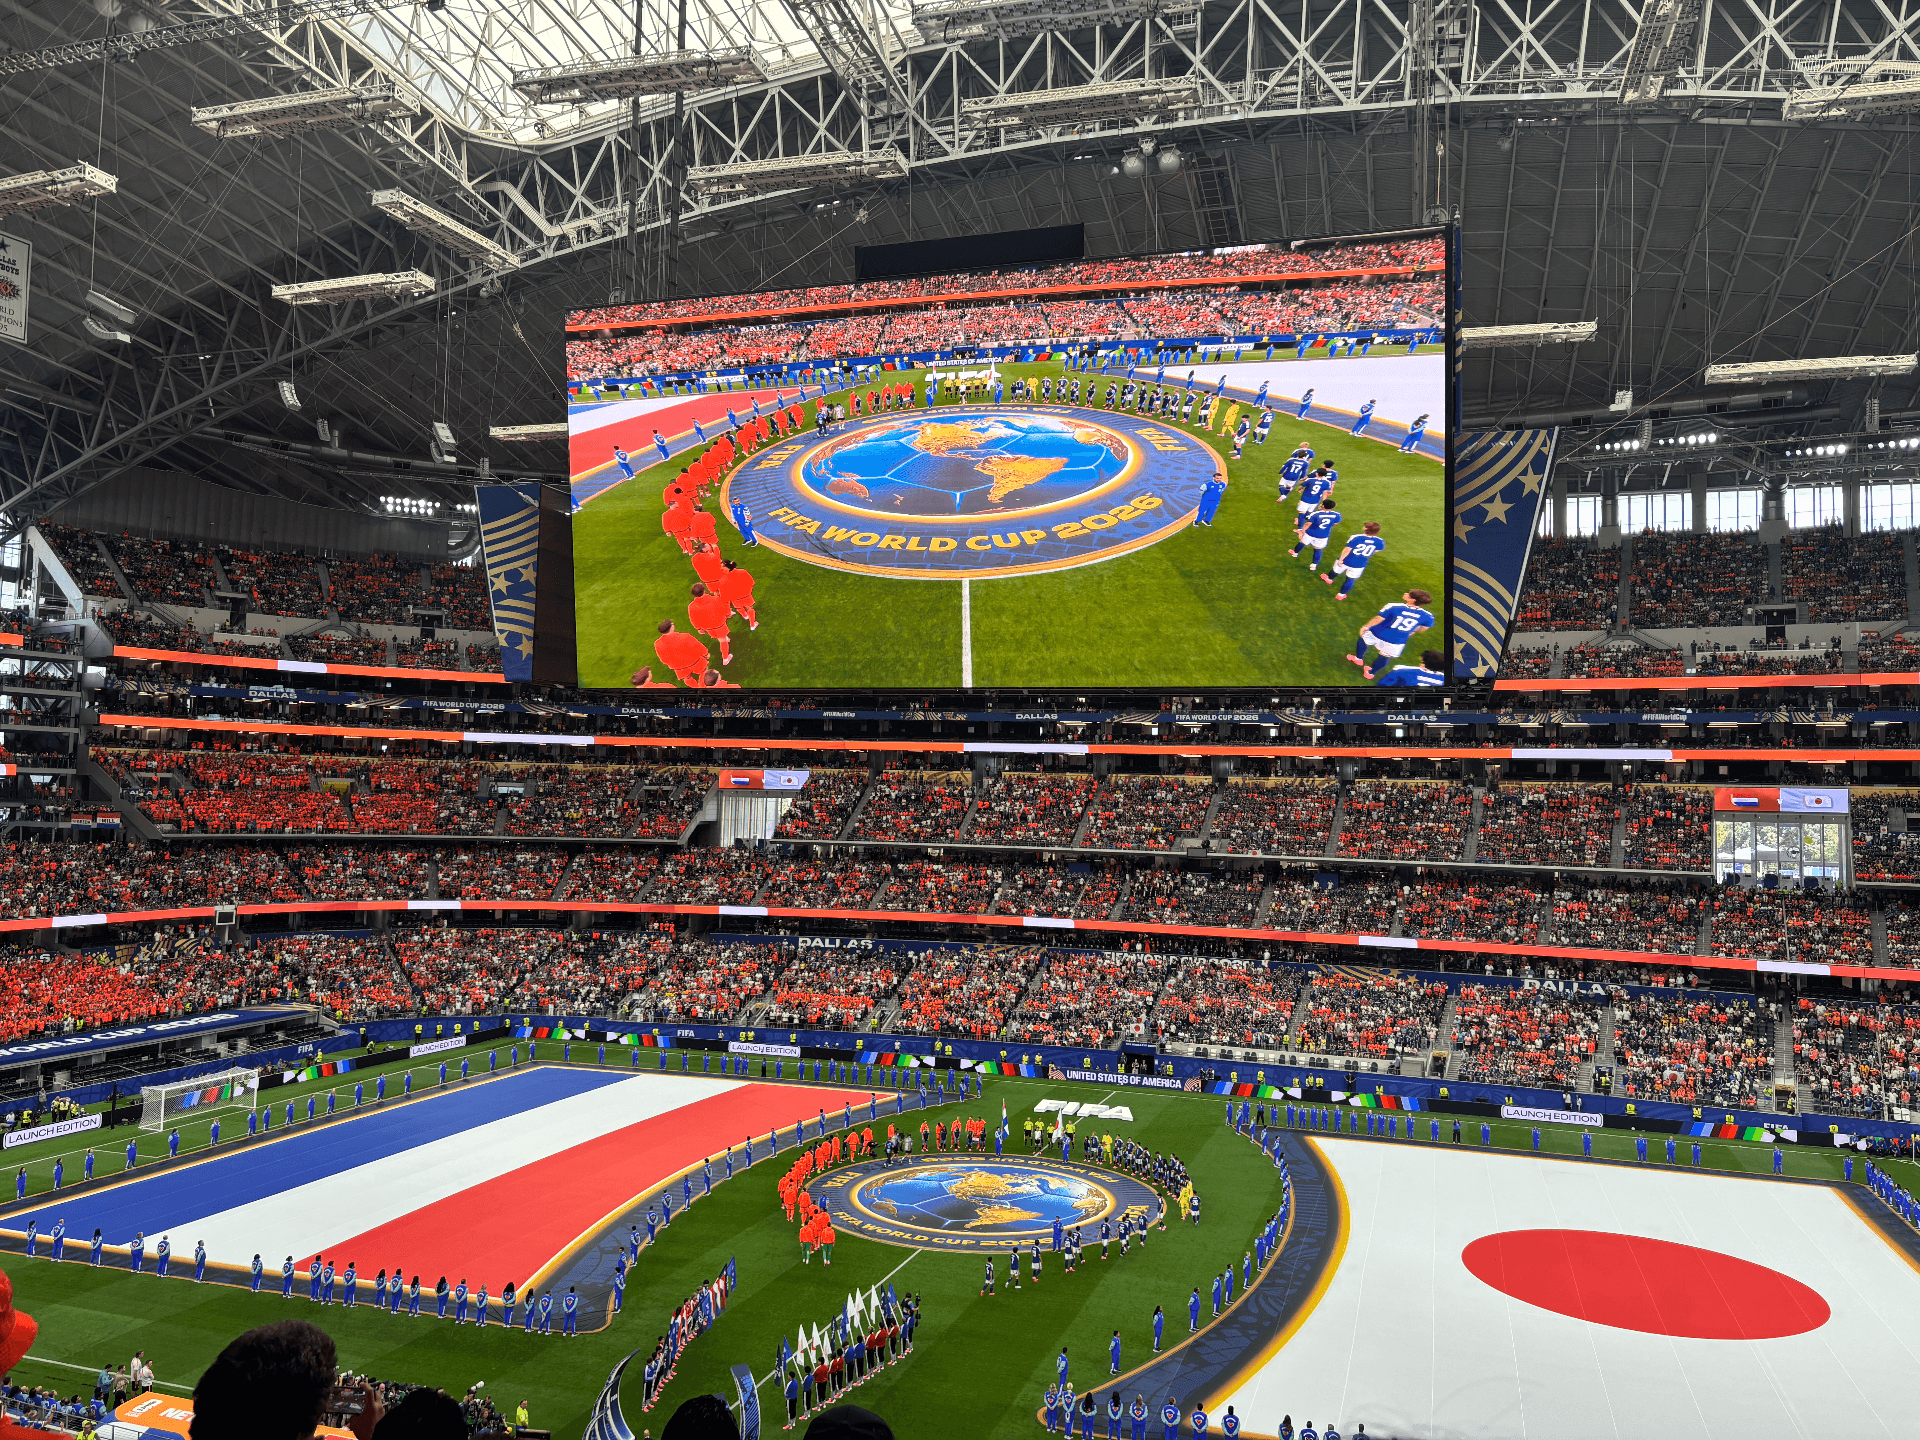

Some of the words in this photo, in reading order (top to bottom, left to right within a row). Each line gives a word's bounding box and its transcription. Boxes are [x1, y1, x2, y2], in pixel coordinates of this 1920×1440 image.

[947, 359, 968, 367] STATES
[976, 356, 1003, 364] AMERICA
[1135, 427, 1189, 451] FIFA
[753, 444, 806, 470] FIFA
[1289, 464, 1302, 474] 17
[1310, 484, 1321, 495] 9
[768, 506, 822, 535] FIFA
[822, 525, 958, 552] WORLD
[966, 529, 1047, 551] CUP
[1051, 494, 1163, 540] 2026
[1318, 519, 1331, 529] 2
[1353, 543, 1376, 557] 20
[1390, 615, 1419, 632] 19
[249, 690, 298, 699] DALLAS
[1387, 714, 1438, 722] DALLAS
[92, 1027, 147, 1040] CUP
[147, 1013, 240, 1031] 2026
[677, 1029, 695, 1037] FIFA
[298, 1043, 314, 1054] FIFA
[412, 1043, 439, 1055] LAUNCH
[440, 1039, 464, 1049] EDITION
[732, 1043, 764, 1053] LAUNCH
[765, 1046, 797, 1055] EDITION
[1066, 1069, 1097, 1081] UNITED
[1097, 1072, 1129, 1085] STATES
[1129, 1075, 1141, 1085] OF
[1141, 1077, 1182, 1089] AMERICA
[1034, 1098, 1134, 1122] FIFA
[1506, 1108, 1552, 1119] LAUNCH
[1553, 1112, 1598, 1124] EDITION
[8, 1126, 55, 1144] LAUNCH
[56, 1117, 98, 1134] EDITION
[822, 1171, 863, 1188] FIFA
[832, 1211, 864, 1226] FIFA
[861, 1223, 930, 1241] WORLD
[931, 1237, 976, 1246] CUP
